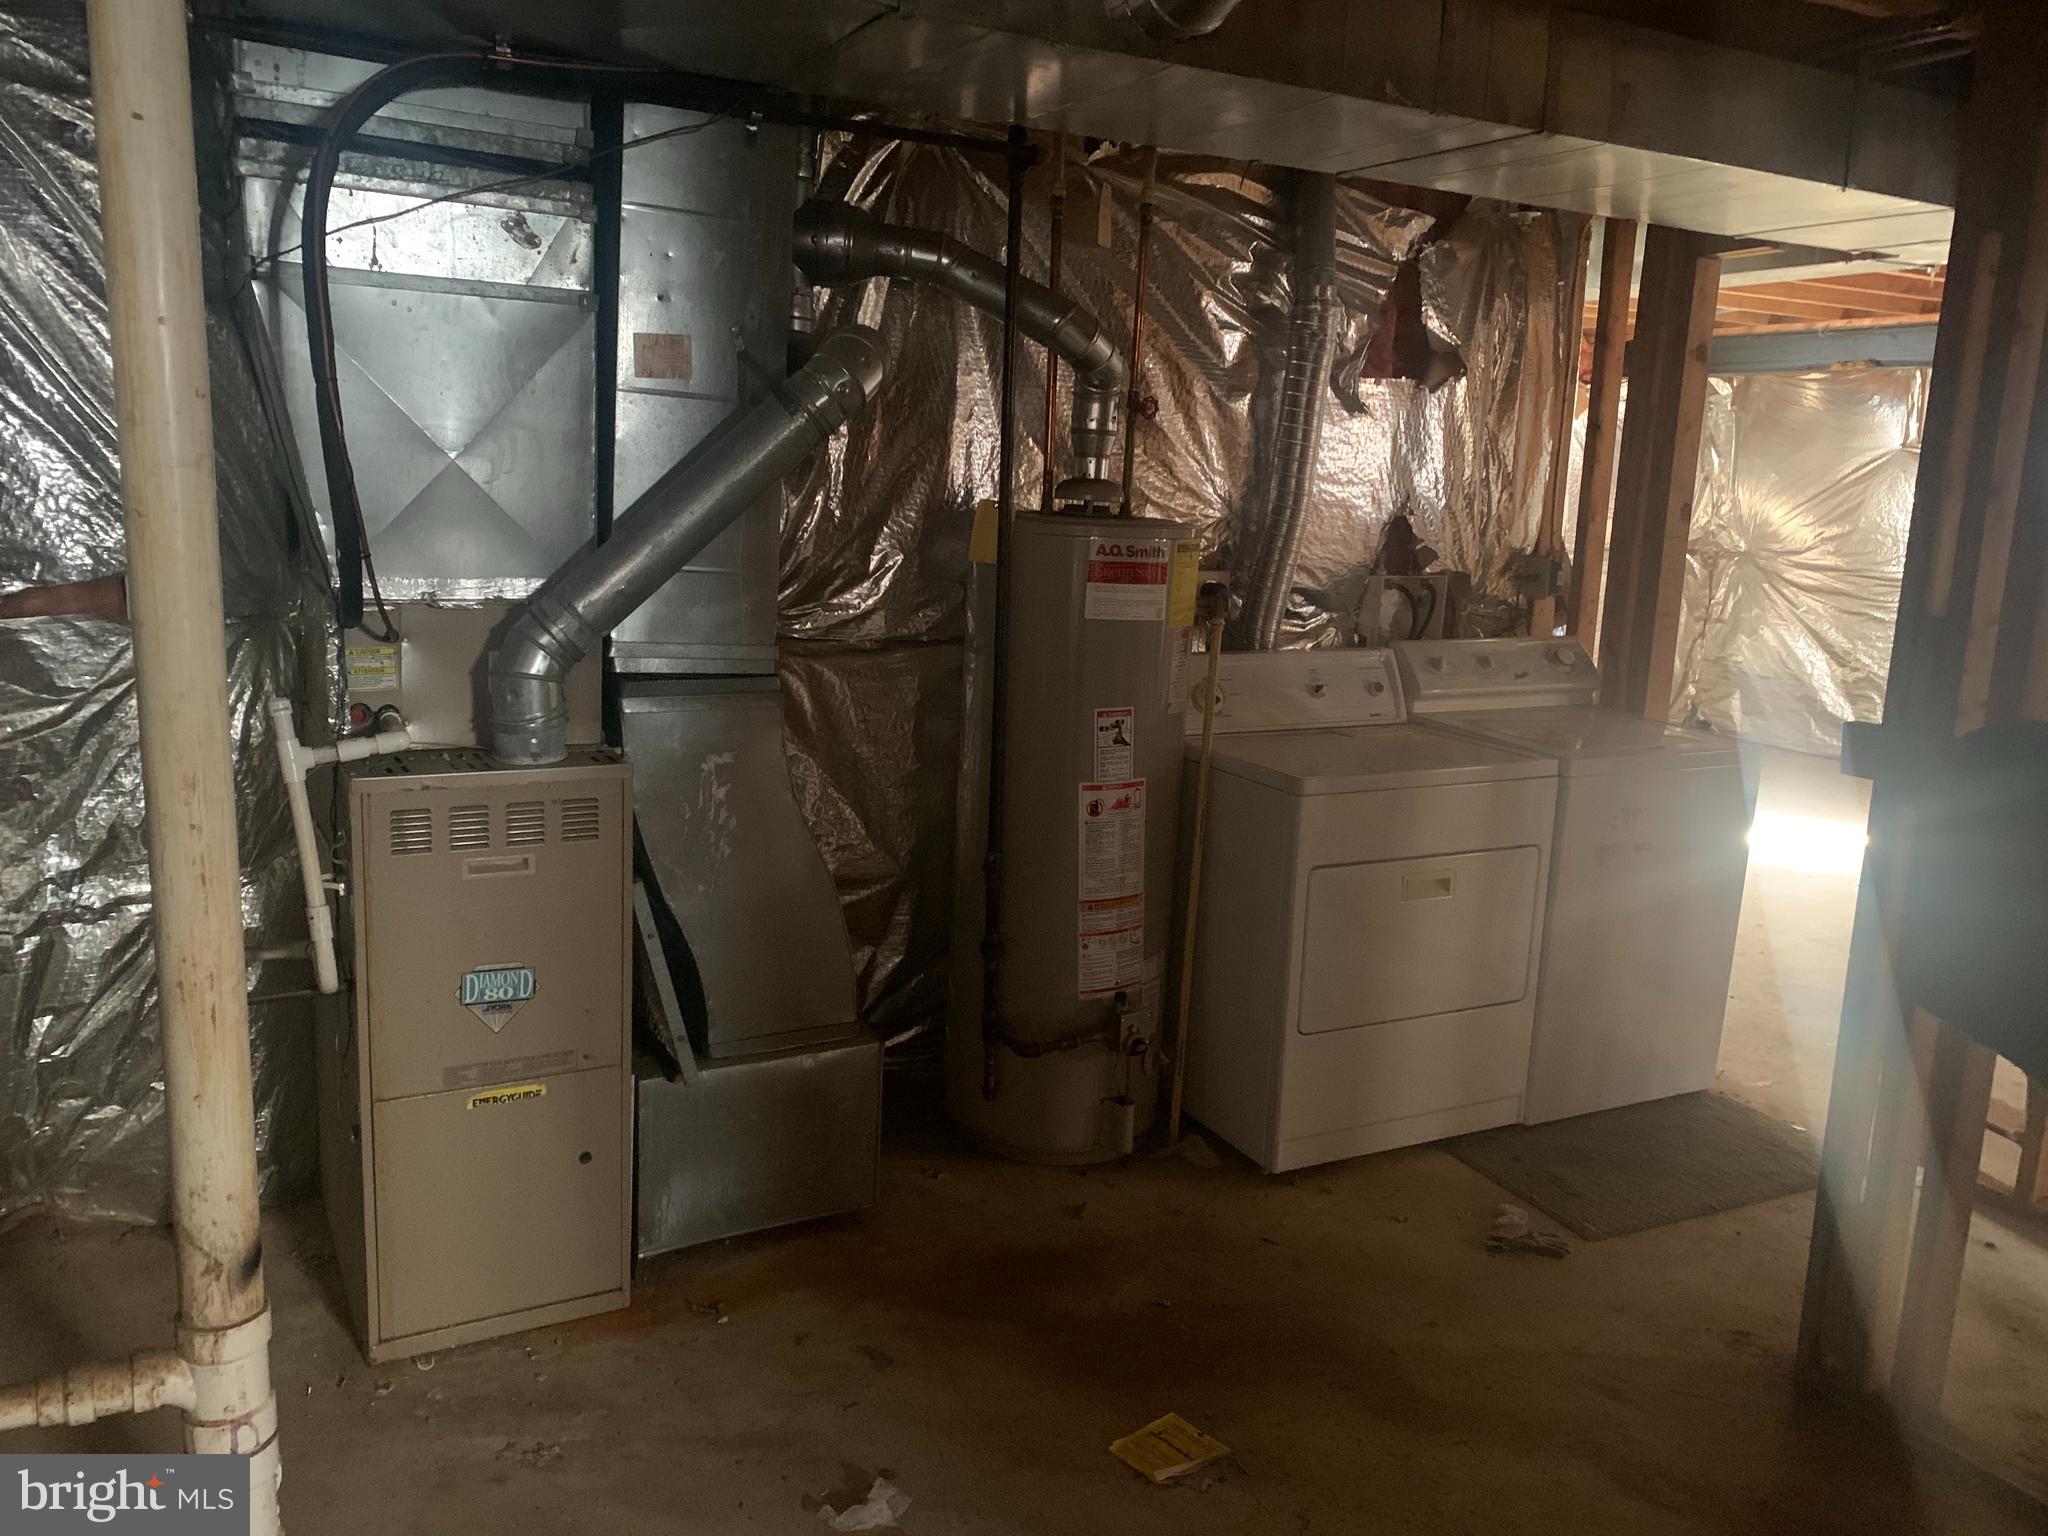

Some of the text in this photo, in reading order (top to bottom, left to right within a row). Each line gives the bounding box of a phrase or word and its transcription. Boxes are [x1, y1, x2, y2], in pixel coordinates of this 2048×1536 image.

[1096, 544, 1123, 557] A.O.
[1126, 545, 1164, 558] Smith
[465, 970, 533, 1003] DIAMOND
[484, 986, 513, 1001] 80
